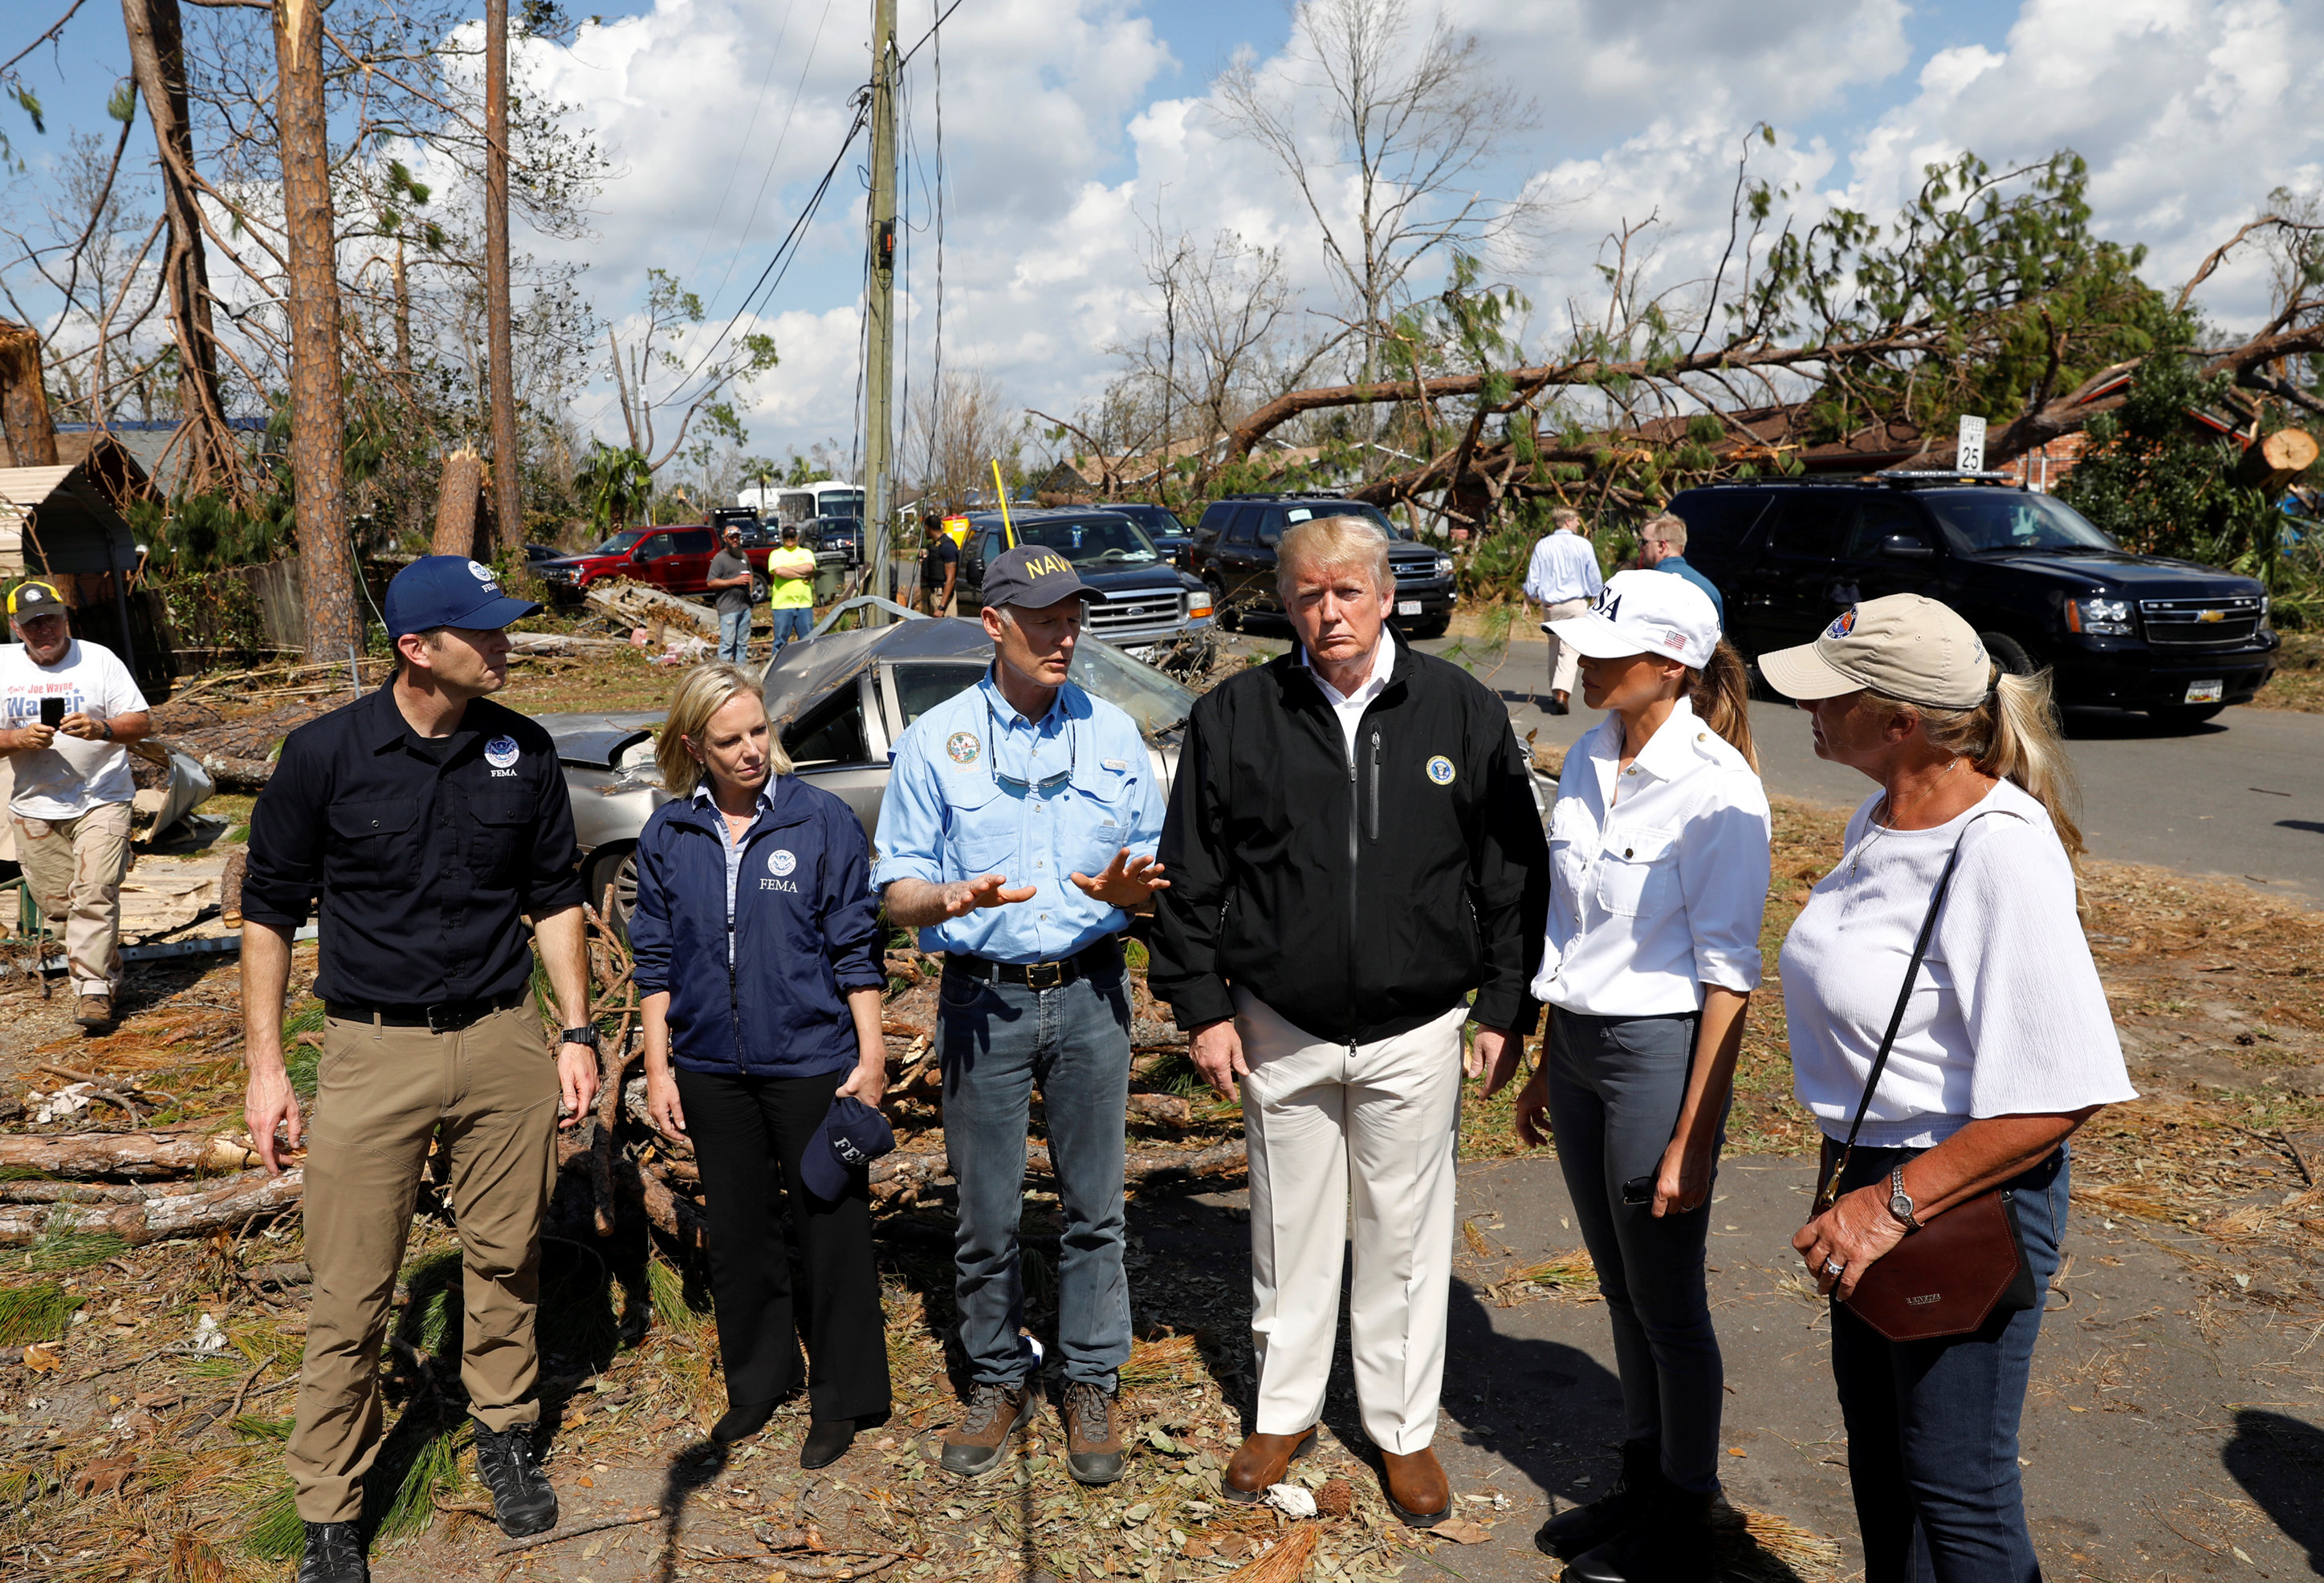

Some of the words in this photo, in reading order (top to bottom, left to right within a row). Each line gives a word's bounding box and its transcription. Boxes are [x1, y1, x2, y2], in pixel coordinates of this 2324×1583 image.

[1962, 446, 1979, 470] 25
[481, 582, 499, 593] FEMA
[1592, 584, 1622, 622] SA
[28, 684, 43, 694] Joe
[46, 682, 73, 694] Wayne
[6, 695, 85, 717] Waer
[490, 768, 518, 777] FEMA
[759, 878, 799, 893] FEMA
[833, 1137, 873, 1165] FEM
